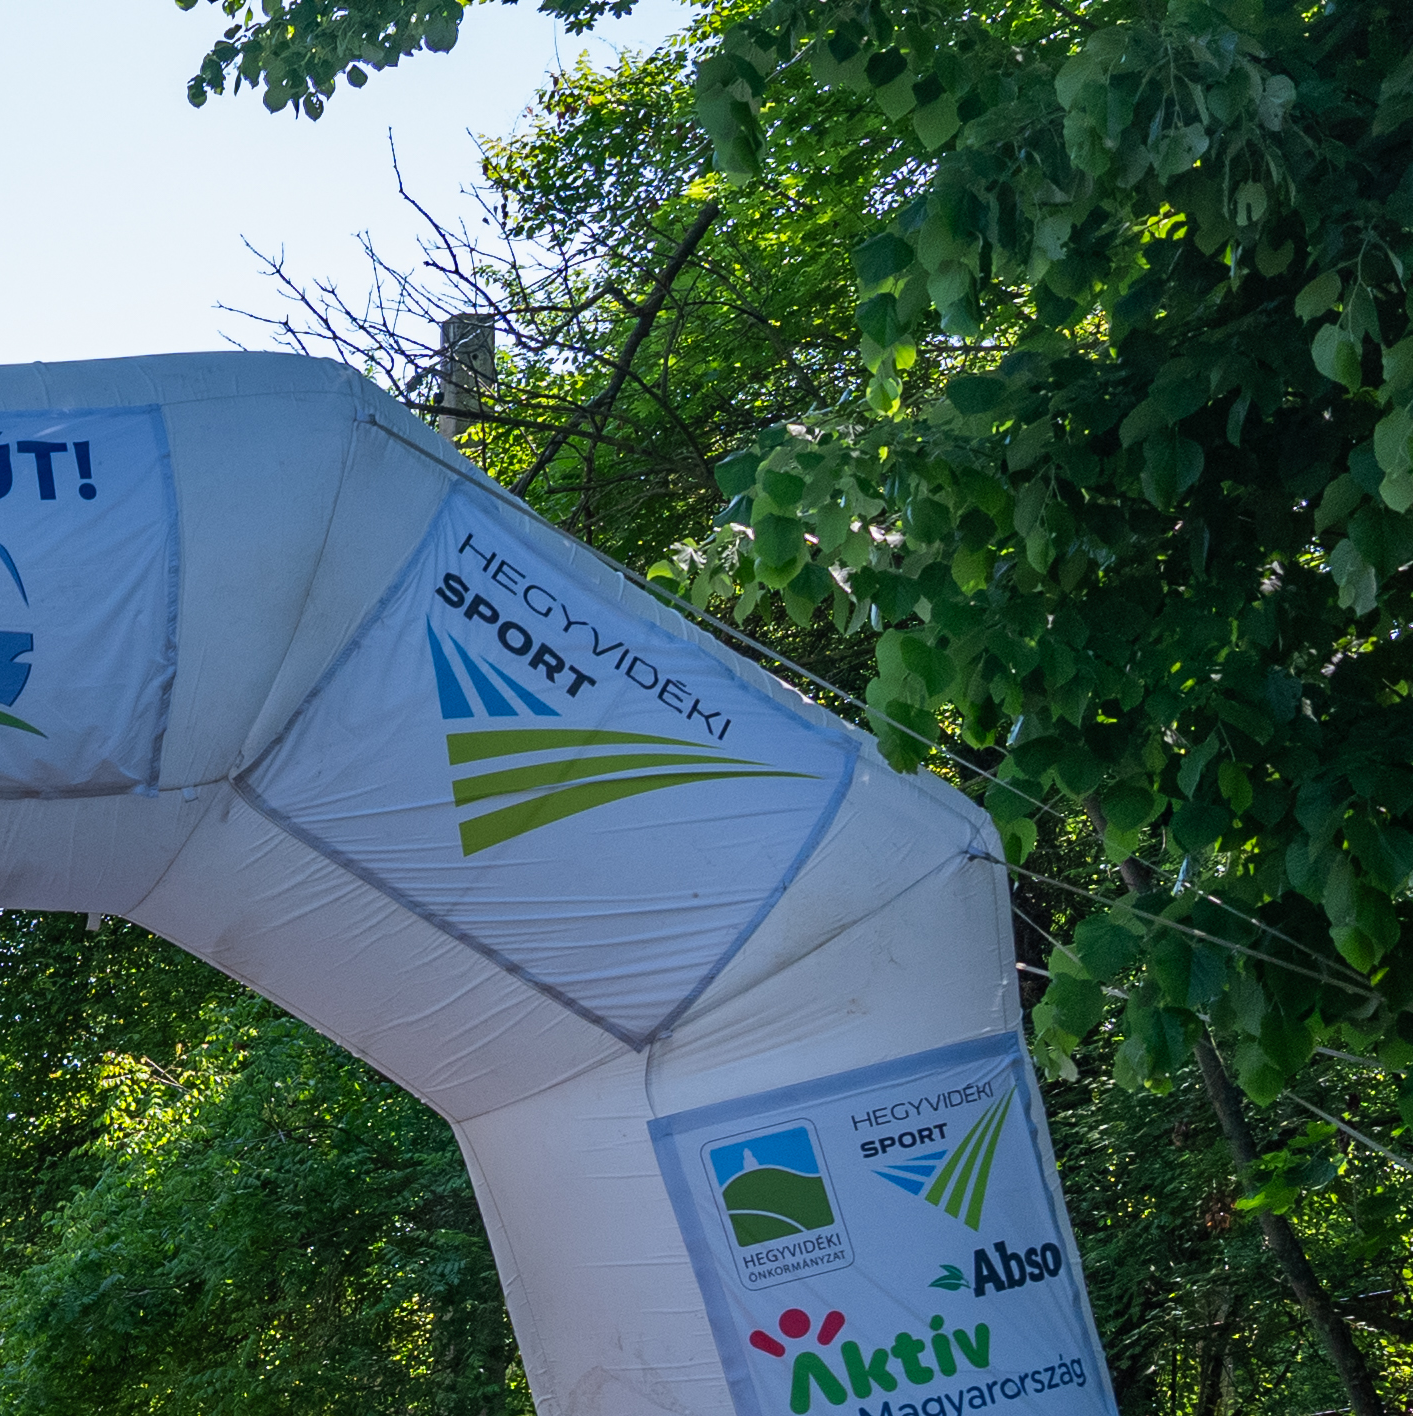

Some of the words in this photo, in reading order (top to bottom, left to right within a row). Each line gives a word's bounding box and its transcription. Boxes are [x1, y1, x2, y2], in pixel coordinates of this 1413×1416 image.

[434, 571, 597, 699] SPORT
[457, 532, 733, 741] HEGYVIDÉKI
[850, 1081, 994, 1132] HEGYVIDÉKI
[859, 1122, 949, 1159] SPORT
[741, 1232, 843, 1270] HEGYVIDÉKI
[748, 1249, 847, 1284] ÖNKORMÁNYZAT
[972, 1239, 1063, 1298] Abso
